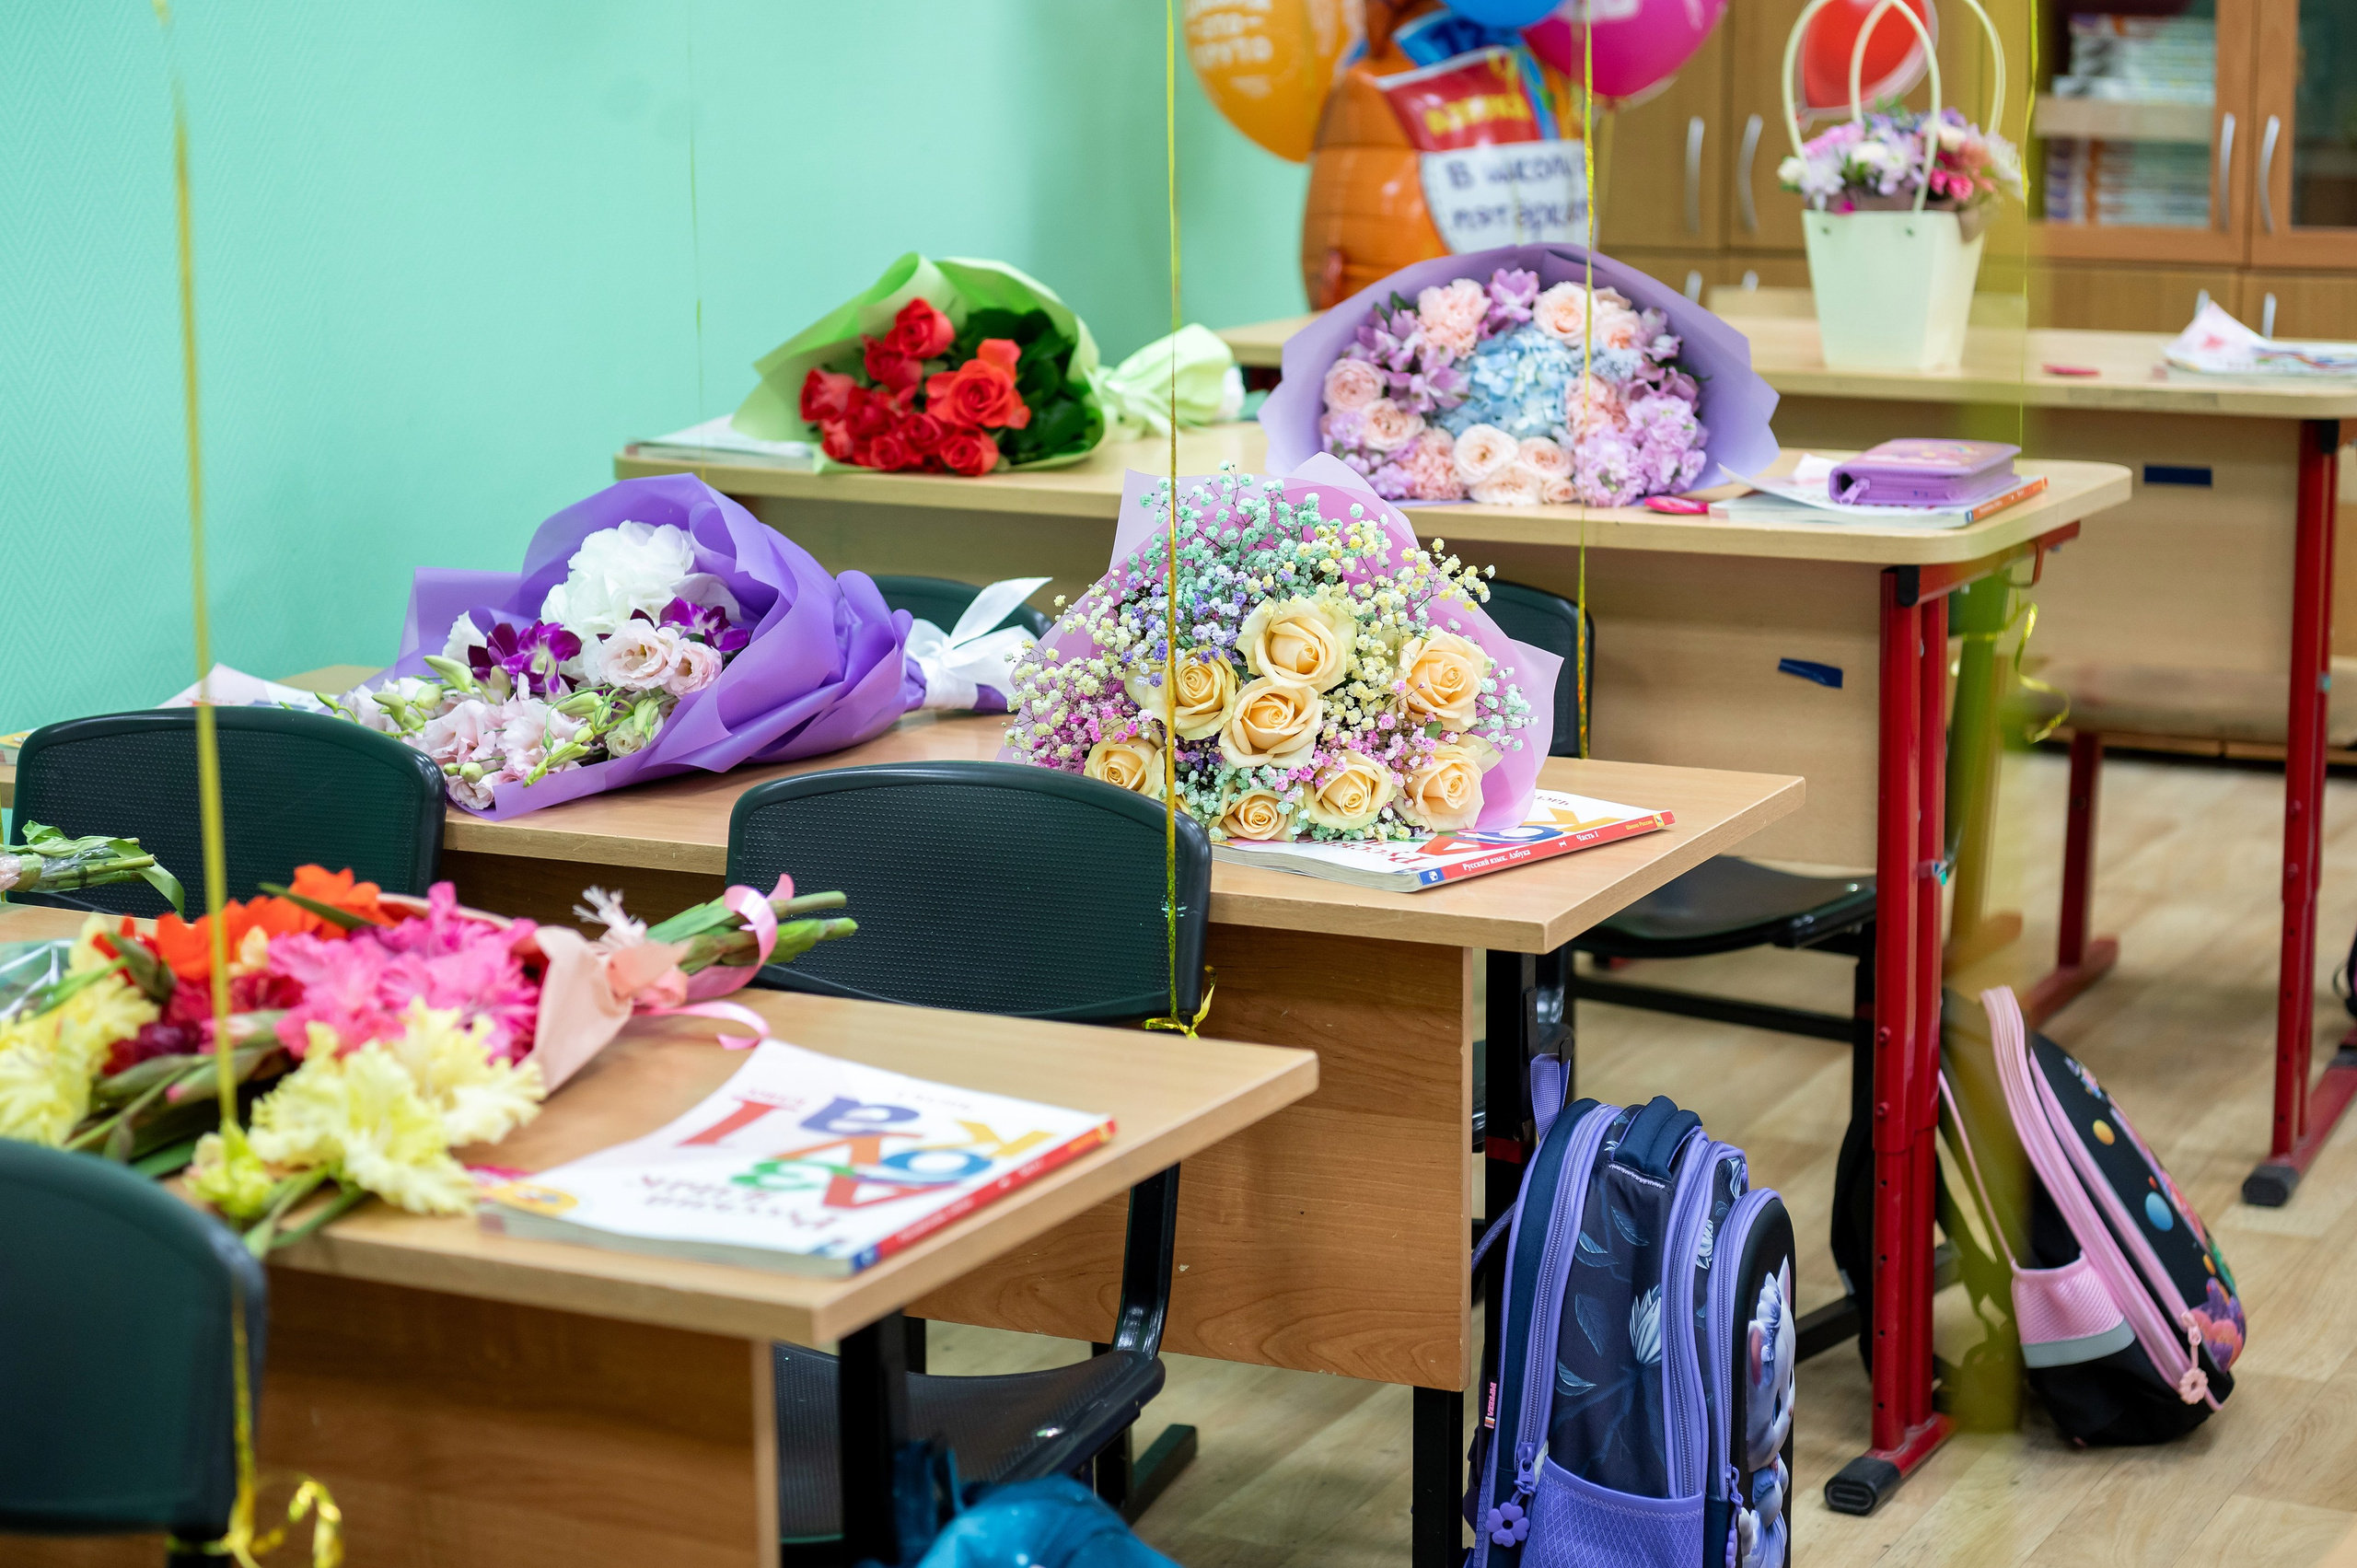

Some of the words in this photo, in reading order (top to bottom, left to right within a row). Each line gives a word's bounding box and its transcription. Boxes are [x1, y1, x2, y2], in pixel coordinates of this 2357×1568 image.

[1575, 831, 1595, 842] Часть
[1462, 858, 1490, 872] Русский
[1509, 848, 1532, 863] Азбука
